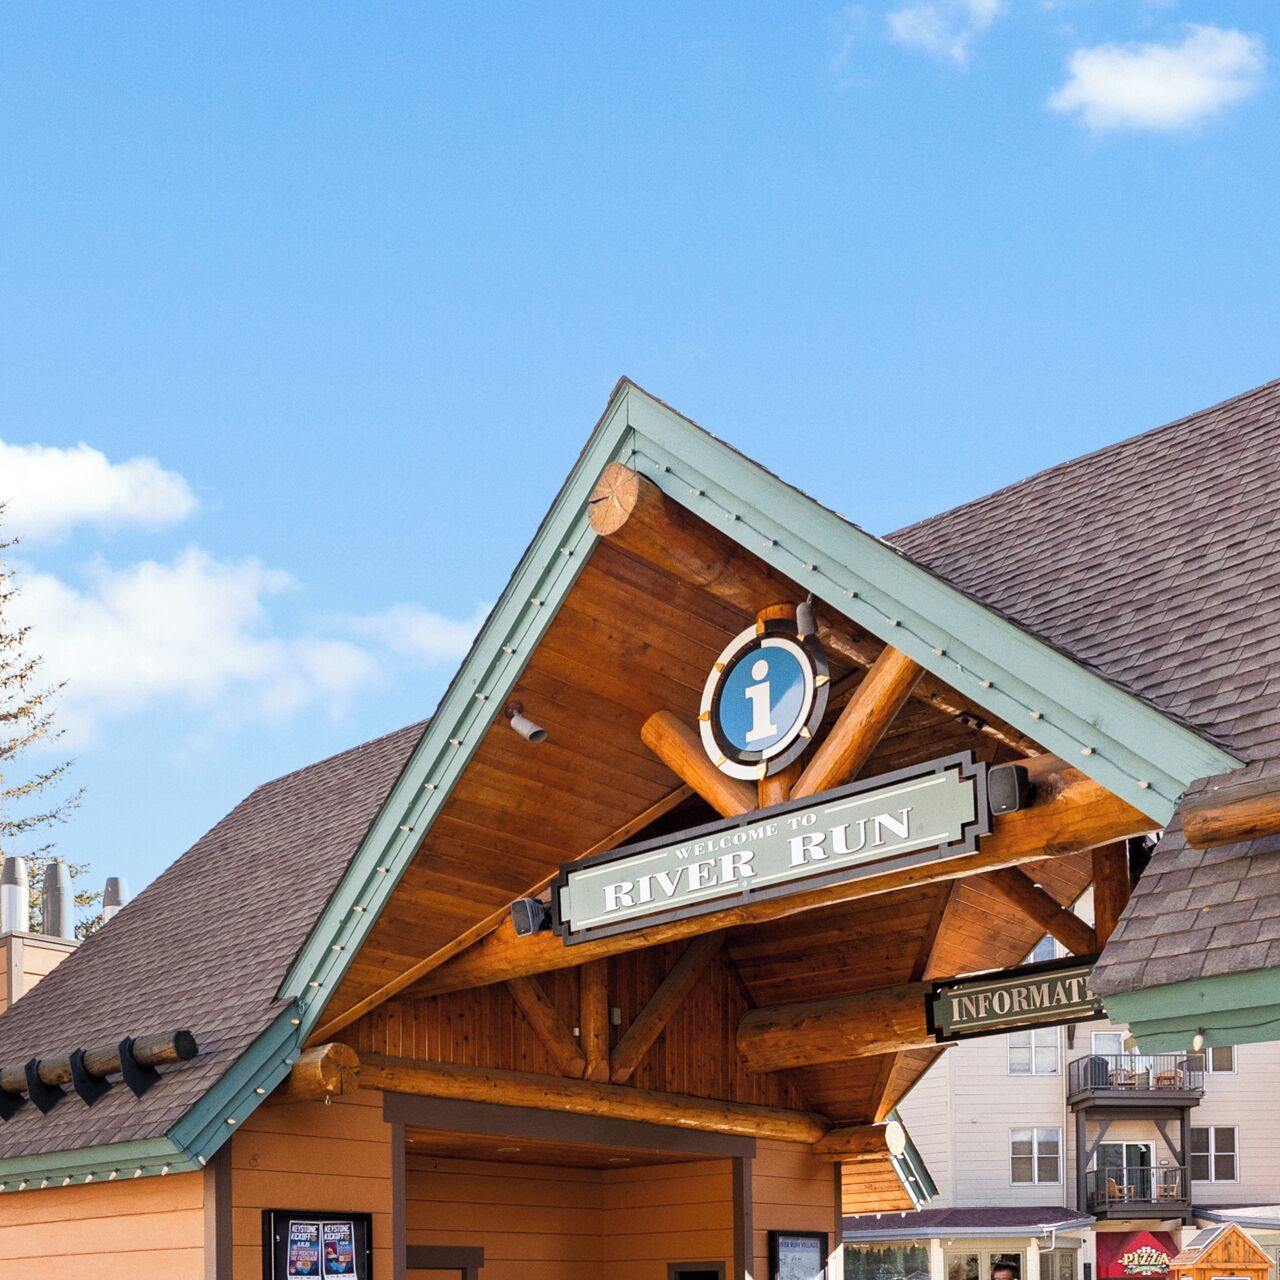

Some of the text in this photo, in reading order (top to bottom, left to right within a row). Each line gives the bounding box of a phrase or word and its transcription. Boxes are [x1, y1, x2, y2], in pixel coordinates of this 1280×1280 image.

[674, 813, 818, 861] WELCOME TO
[602, 807, 913, 914] RIVER RUN
[292, 1225, 318, 1234] KEYSTONE
[324, 1225, 350, 1234] KEYSTONE
[1122, 1253, 1170, 1266] PIZZA
